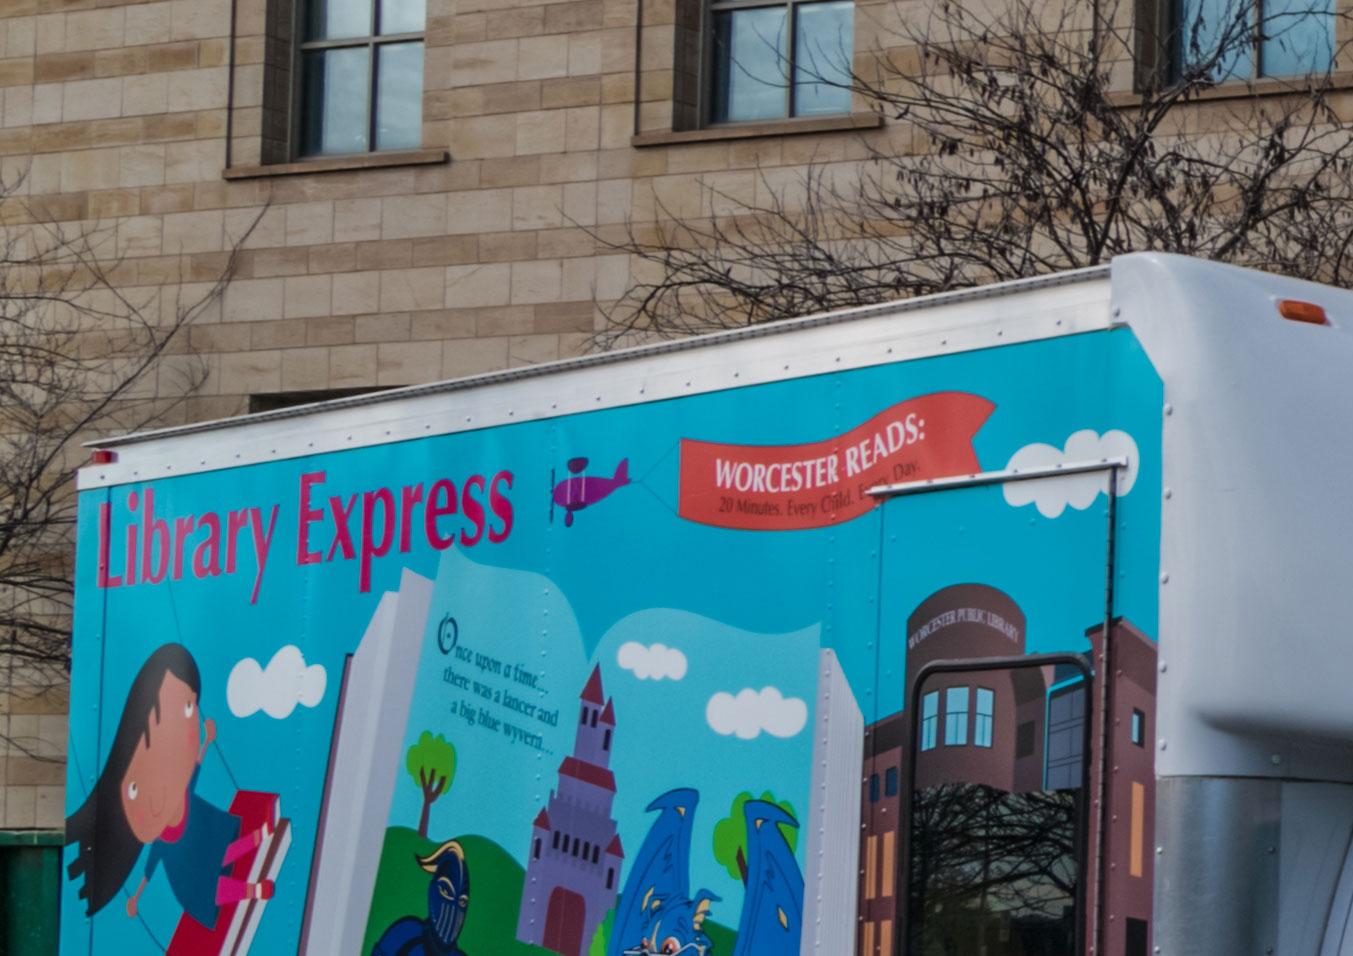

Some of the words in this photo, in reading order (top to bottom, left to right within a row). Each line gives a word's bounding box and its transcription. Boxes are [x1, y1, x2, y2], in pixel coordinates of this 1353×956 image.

[714, 454, 839, 494] WORCESTER
[845, 413, 926, 478] READS:
[97, 487, 280, 606] Library
[296, 469, 515, 594] Express
[719, 496, 734, 513] 20
[736, 498, 783, 516] Minutes.
[787, 501, 821, 517] Every
[437, 611, 473, 664] Once
[475, 651, 502, 675] upon
[503, 663, 512, 679] a
[513, 662, 550, 694] time...
[908, 609, 957, 650] WORCESTER
[957, 607, 986, 624] PUBLIC
[987, 610, 1020, 645] LIBRARY
[443, 665, 471, 691] there
[473, 680, 493, 700] was
[494, 690, 501, 704] a
[502, 688, 538, 718] lancer
[537, 708, 560, 728] and
[450, 700, 458, 715] a
[459, 698, 477, 727] big
[477, 707, 502, 733] blue
